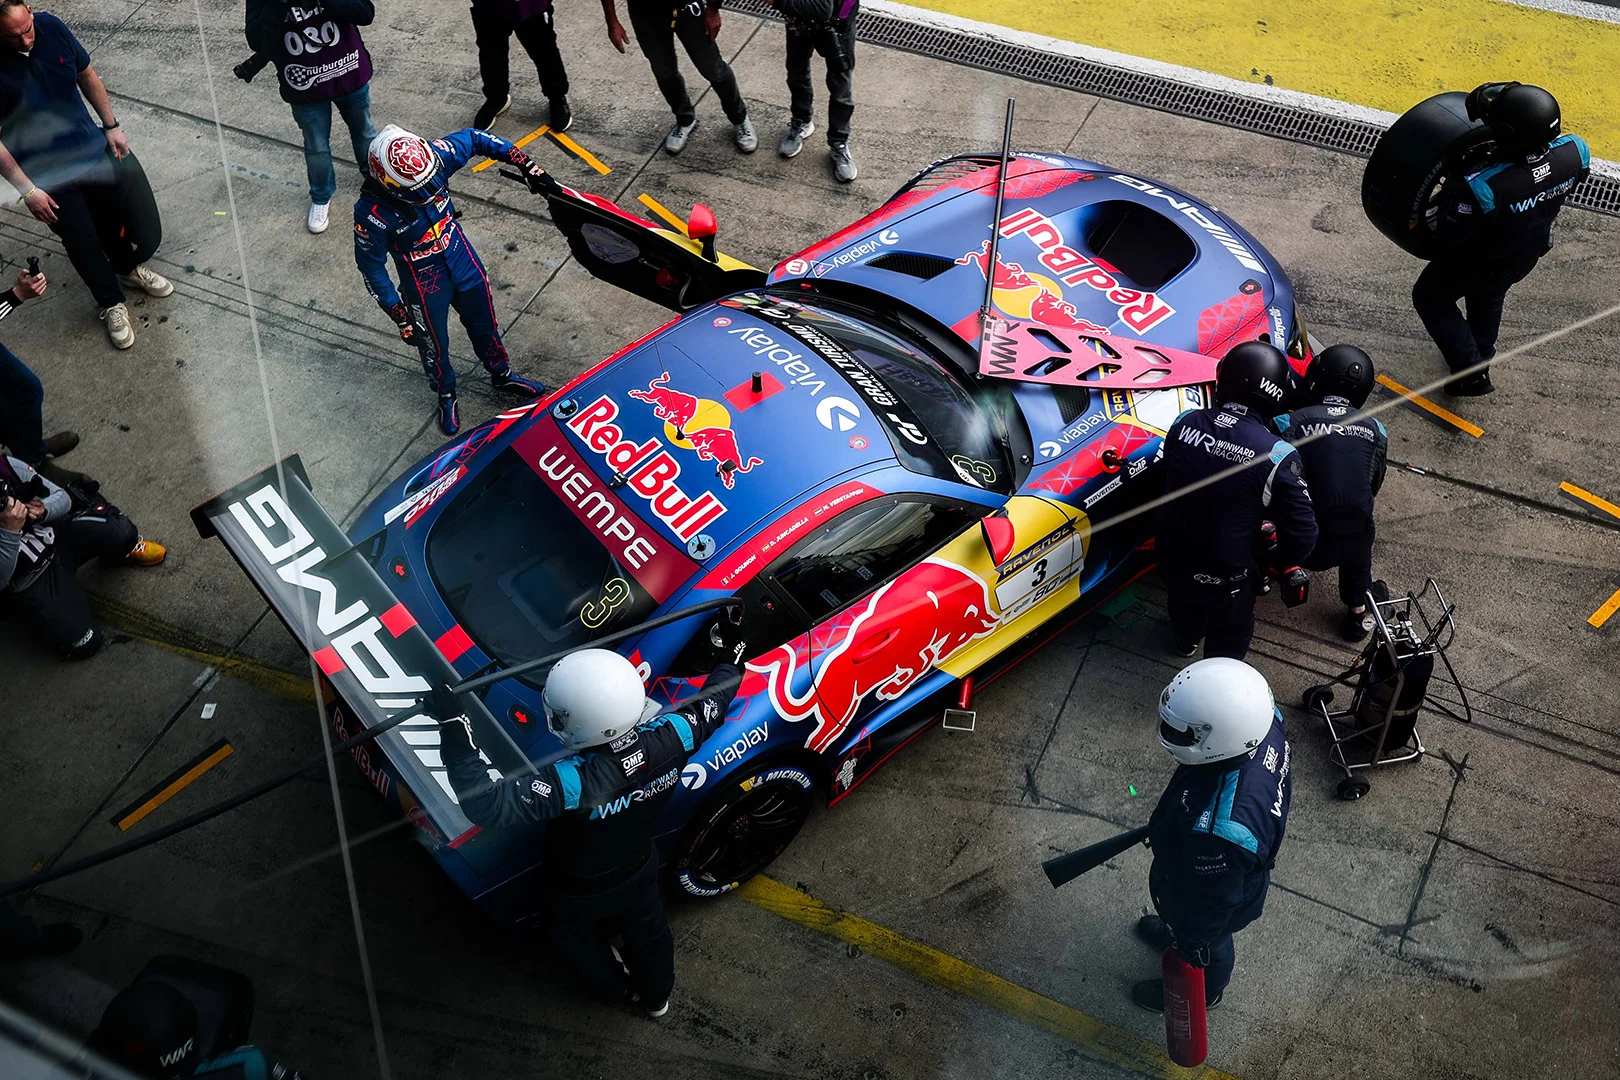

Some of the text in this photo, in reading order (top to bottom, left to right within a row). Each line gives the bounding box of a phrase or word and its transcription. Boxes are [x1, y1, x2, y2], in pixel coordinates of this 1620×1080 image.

[306, 49, 359, 76] nürburgring
[1532, 164, 1551, 178] OMP
[1413, 160, 1443, 211] MICHELIN
[1108, 174, 1219, 231] AMG
[367, 214, 387, 230] sparco
[833, 240, 881, 269] viaplay
[787, 325, 856, 369] TURISMO
[804, 325, 843, 352] SIMULATOR
[728, 327, 826, 396] viaplay
[842, 351, 870, 374] DRIVING
[845, 371, 893, 406] GRAN
[869, 375, 887, 391] REAL
[884, 391, 899, 405] THE
[1216, 414, 1238, 425] OMP
[1327, 406, 1347, 416] OMP
[1058, 410, 1107, 444] viaplay
[1346, 425, 1374, 437] WINWARD
[1347, 430, 1374, 443] RACING
[1214, 448, 1252, 466] RACING
[1217, 440, 1256, 458] WINWARD
[951, 454, 996, 484] 3
[1128, 459, 1147, 476] OMP
[829, 488, 864, 507] VERSTAPPEN
[1087, 480, 1120, 505] RAVENOL
[538, 445, 657, 570] WEMPE
[776, 517, 809, 543] JUNCADELLA
[1003, 528, 1070, 576] RAVENOL
[734, 554, 757, 576] GOUNON
[1031, 558, 1048, 587] 3
[228, 484, 433, 693] AMG
[580, 577, 630, 628] 3
[706, 721, 769, 771] viaplay
[1265, 746, 1276, 770] OMP
[623, 753, 644, 769] OMP
[531, 781, 552, 795] OMP
[645, 775, 679, 799] RACING
[765, 770, 812, 789] MICHELIN
[679, 873, 720, 896] MICHELIN
